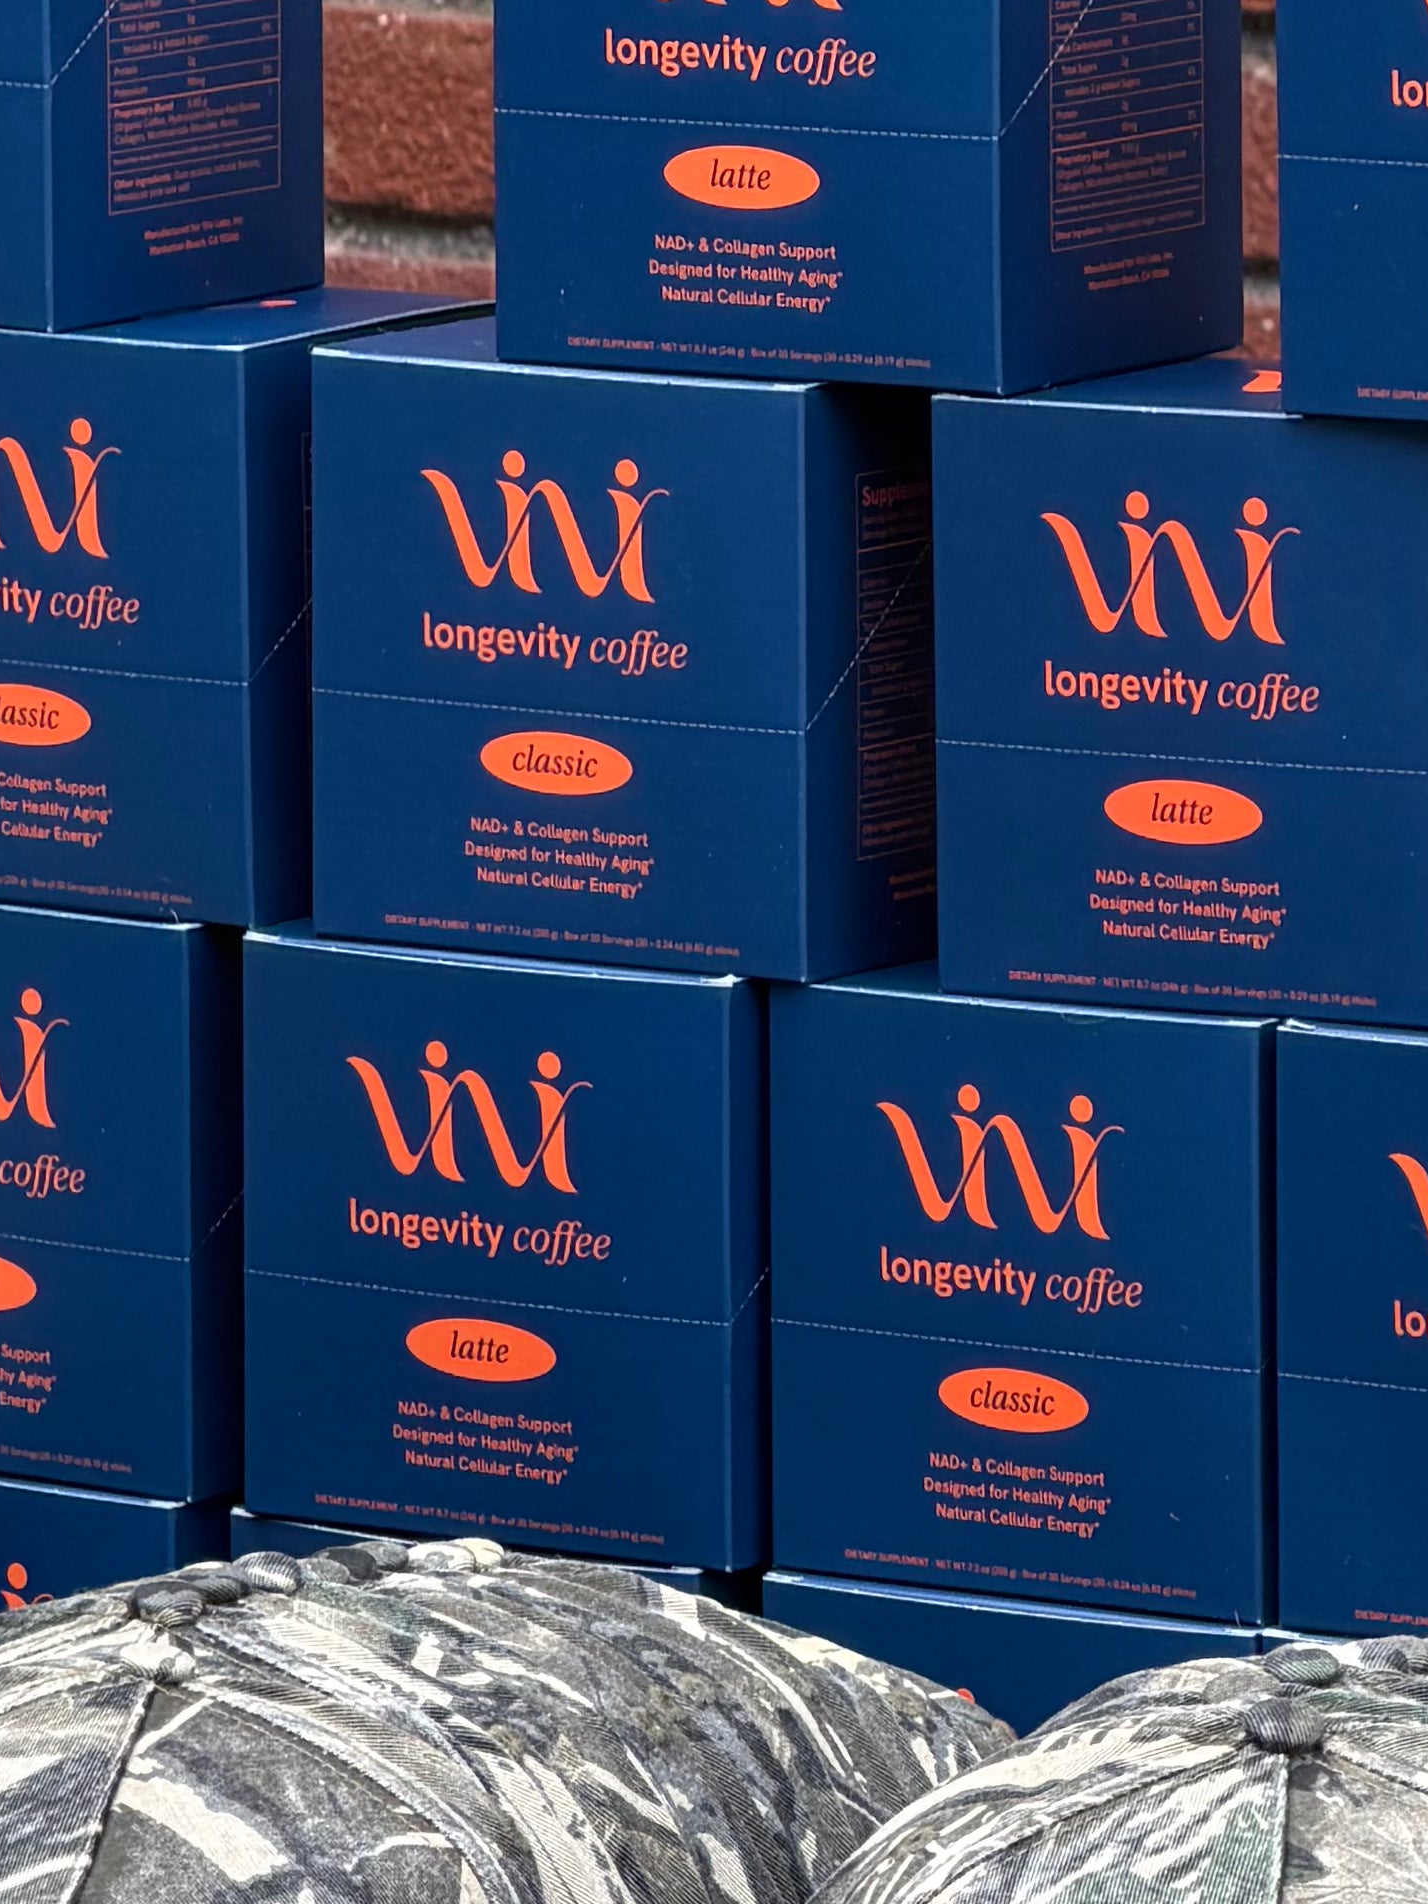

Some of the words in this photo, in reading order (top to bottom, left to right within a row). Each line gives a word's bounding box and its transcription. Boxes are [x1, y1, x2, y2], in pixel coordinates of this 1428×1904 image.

[604, 28, 767, 82] longevity
[774, 38, 876, 87] coffee
[710, 158, 771, 190] latte
[653, 234, 695, 252] NAD+
[697, 238, 709, 253] &
[711, 238, 775, 260] Collagen
[777, 242, 836, 262] Support
[648, 259, 714, 281] Designed
[715, 264, 737, 279] for
[738, 266, 794, 287] Healthy
[661, 287, 713, 303] Natural
[715, 288, 772, 307] Cellular
[48, 585, 140, 631] coffee
[422, 612, 581, 670] longevity
[588, 630, 688, 677] coffee
[1043, 660, 1208, 716] longevity
[1216, 673, 1319, 721] coffee
[512, 744, 598, 779] classic
[1151, 792, 1213, 825] latte
[469, 817, 509, 835] NAD+
[513, 821, 524, 837] &
[526, 822, 589, 845] Collagen
[591, 827, 648, 848] Support
[464, 841, 529, 863] Designed
[529, 848, 550, 863] for
[553, 850, 608, 871] Healthy
[476, 867, 528, 886] Natural
[530, 872, 585, 891] Cellular
[1094, 869, 1135, 886] NAD+
[1139, 872, 1151, 888] &
[1153, 873, 1218, 895] Collagen
[1220, 878, 1279, 899] Support
[1089, 894, 1155, 916] Designed
[1156, 899, 1180, 915] for
[1181, 902, 1237, 921] Healthy
[1102, 921, 1155, 939] Natural
[1158, 924, 1214, 943] Cellular
[348, 1198, 504, 1259] longevity
[511, 1220, 611, 1267] coffee
[879, 1246, 1037, 1306] longevity
[1043, 1267, 1143, 1315] coffee
[450, 1330, 509, 1364] latte
[970, 1380, 1055, 1416] classic
[396, 1401, 436, 1419] NAD+
[439, 1407, 450, 1421] &
[452, 1407, 514, 1430] Collagen
[516, 1414, 572, 1435] Support
[392, 1425, 455, 1447] Designed
[455, 1432, 477, 1448] for
[479, 1436, 533, 1456] Healthy
[404, 1450, 455, 1470] Natural
[457, 1456, 510, 1477] Cellular
[928, 1452, 967, 1471] NAD+
[971, 1458, 982, 1473] &
[984, 1459, 1046, 1482] Collagen
[1048, 1466, 1105, 1487] Support
[923, 1476, 986, 1499] Designed
[987, 1484, 1010, 1500] for
[1010, 1488, 1064, 1511] Healthy
[934, 1504, 987, 1523] Natural
[988, 1509, 1042, 1529] Cellular
